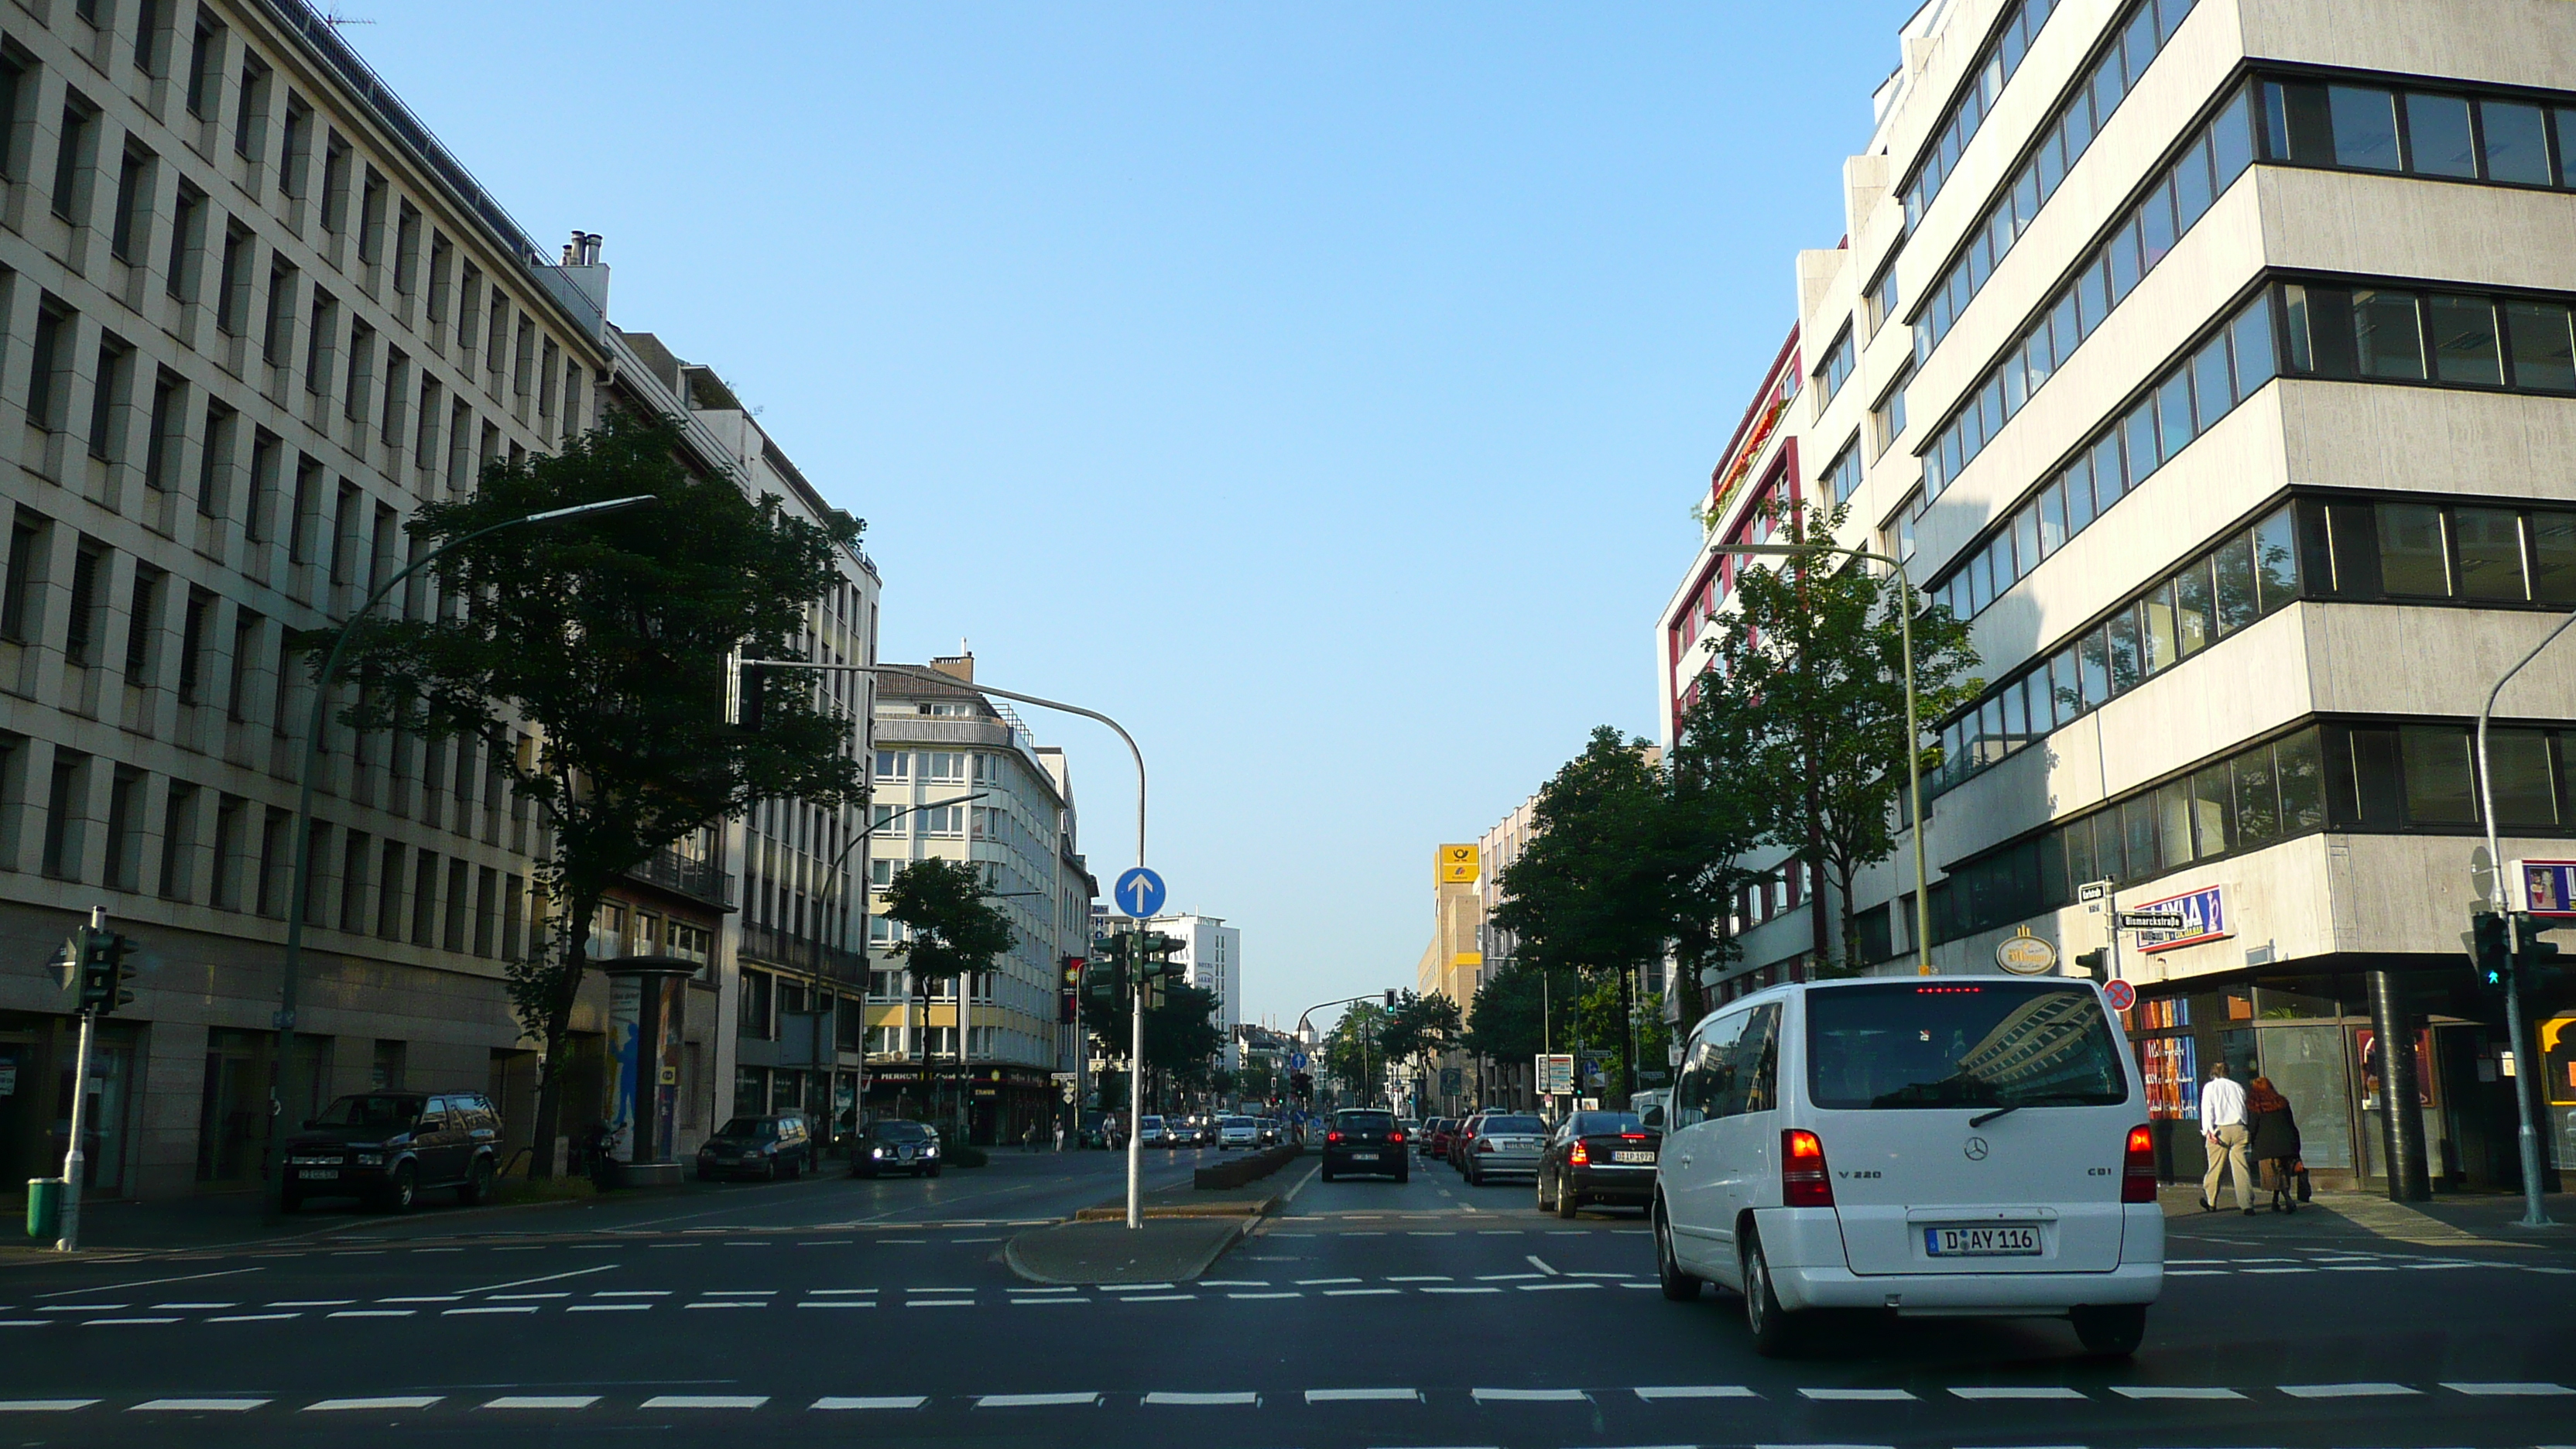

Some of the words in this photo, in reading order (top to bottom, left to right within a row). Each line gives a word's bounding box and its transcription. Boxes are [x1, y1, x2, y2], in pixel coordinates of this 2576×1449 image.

[2125, 915, 2180, 928] Bismarckstraße
[1945, 1231, 1959, 1250] D
[1971, 1230, 1994, 1249] AY
[1998, 1230, 2033, 1249] 116
